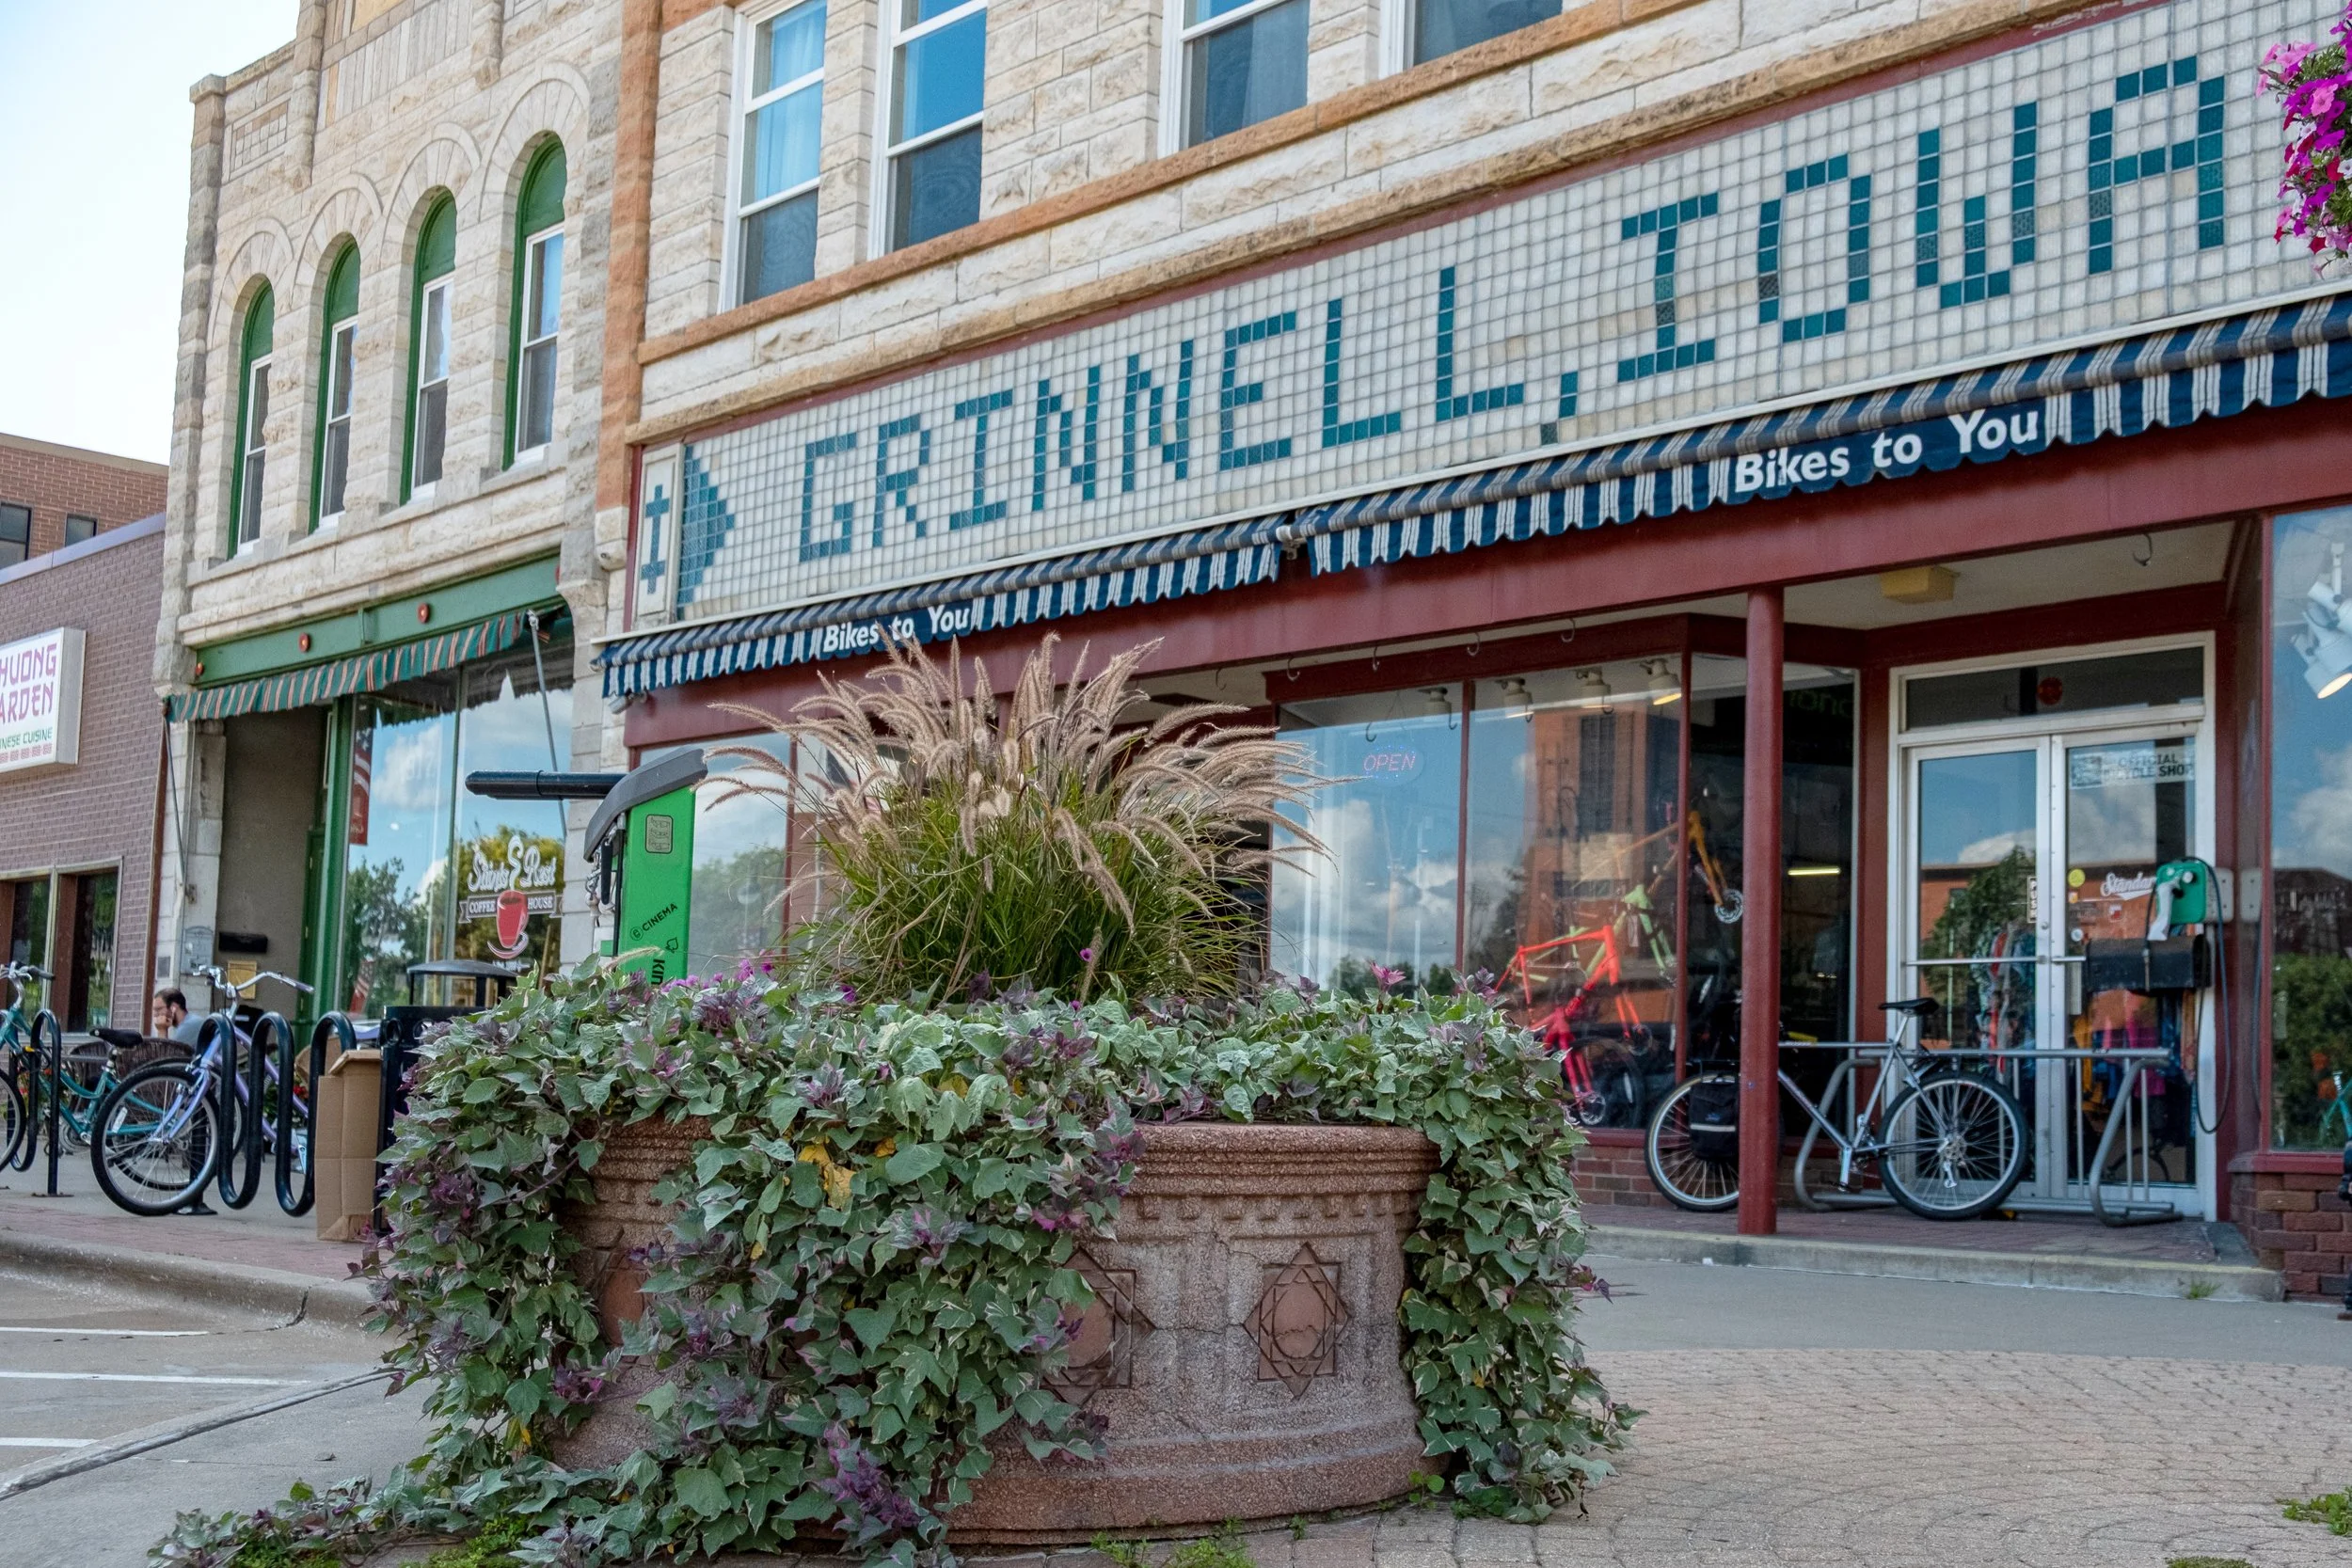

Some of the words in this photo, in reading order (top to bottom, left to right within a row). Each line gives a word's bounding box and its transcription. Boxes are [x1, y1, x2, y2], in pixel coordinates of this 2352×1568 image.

[1617, 55, 2225, 383] IOWA
[1736, 445, 1849, 493] Bikes
[1871, 431, 1922, 468] to
[1948, 410, 2039, 453] You
[822, 621, 880, 653] Bikes
[891, 615, 914, 641] to
[927, 604, 970, 635] You
[23, 727, 54, 744] CUISINE
[1363, 752, 1416, 771] OPEN
[2117, 753, 2178, 768] OFFICIAL
[519, 847, 557, 888] Rest
[2100, 871, 2157, 897] Standar
[469, 899, 496, 914] COFFEE
[527, 895, 553, 910] HOUSE
[642, 903, 678, 931] CINEMA
